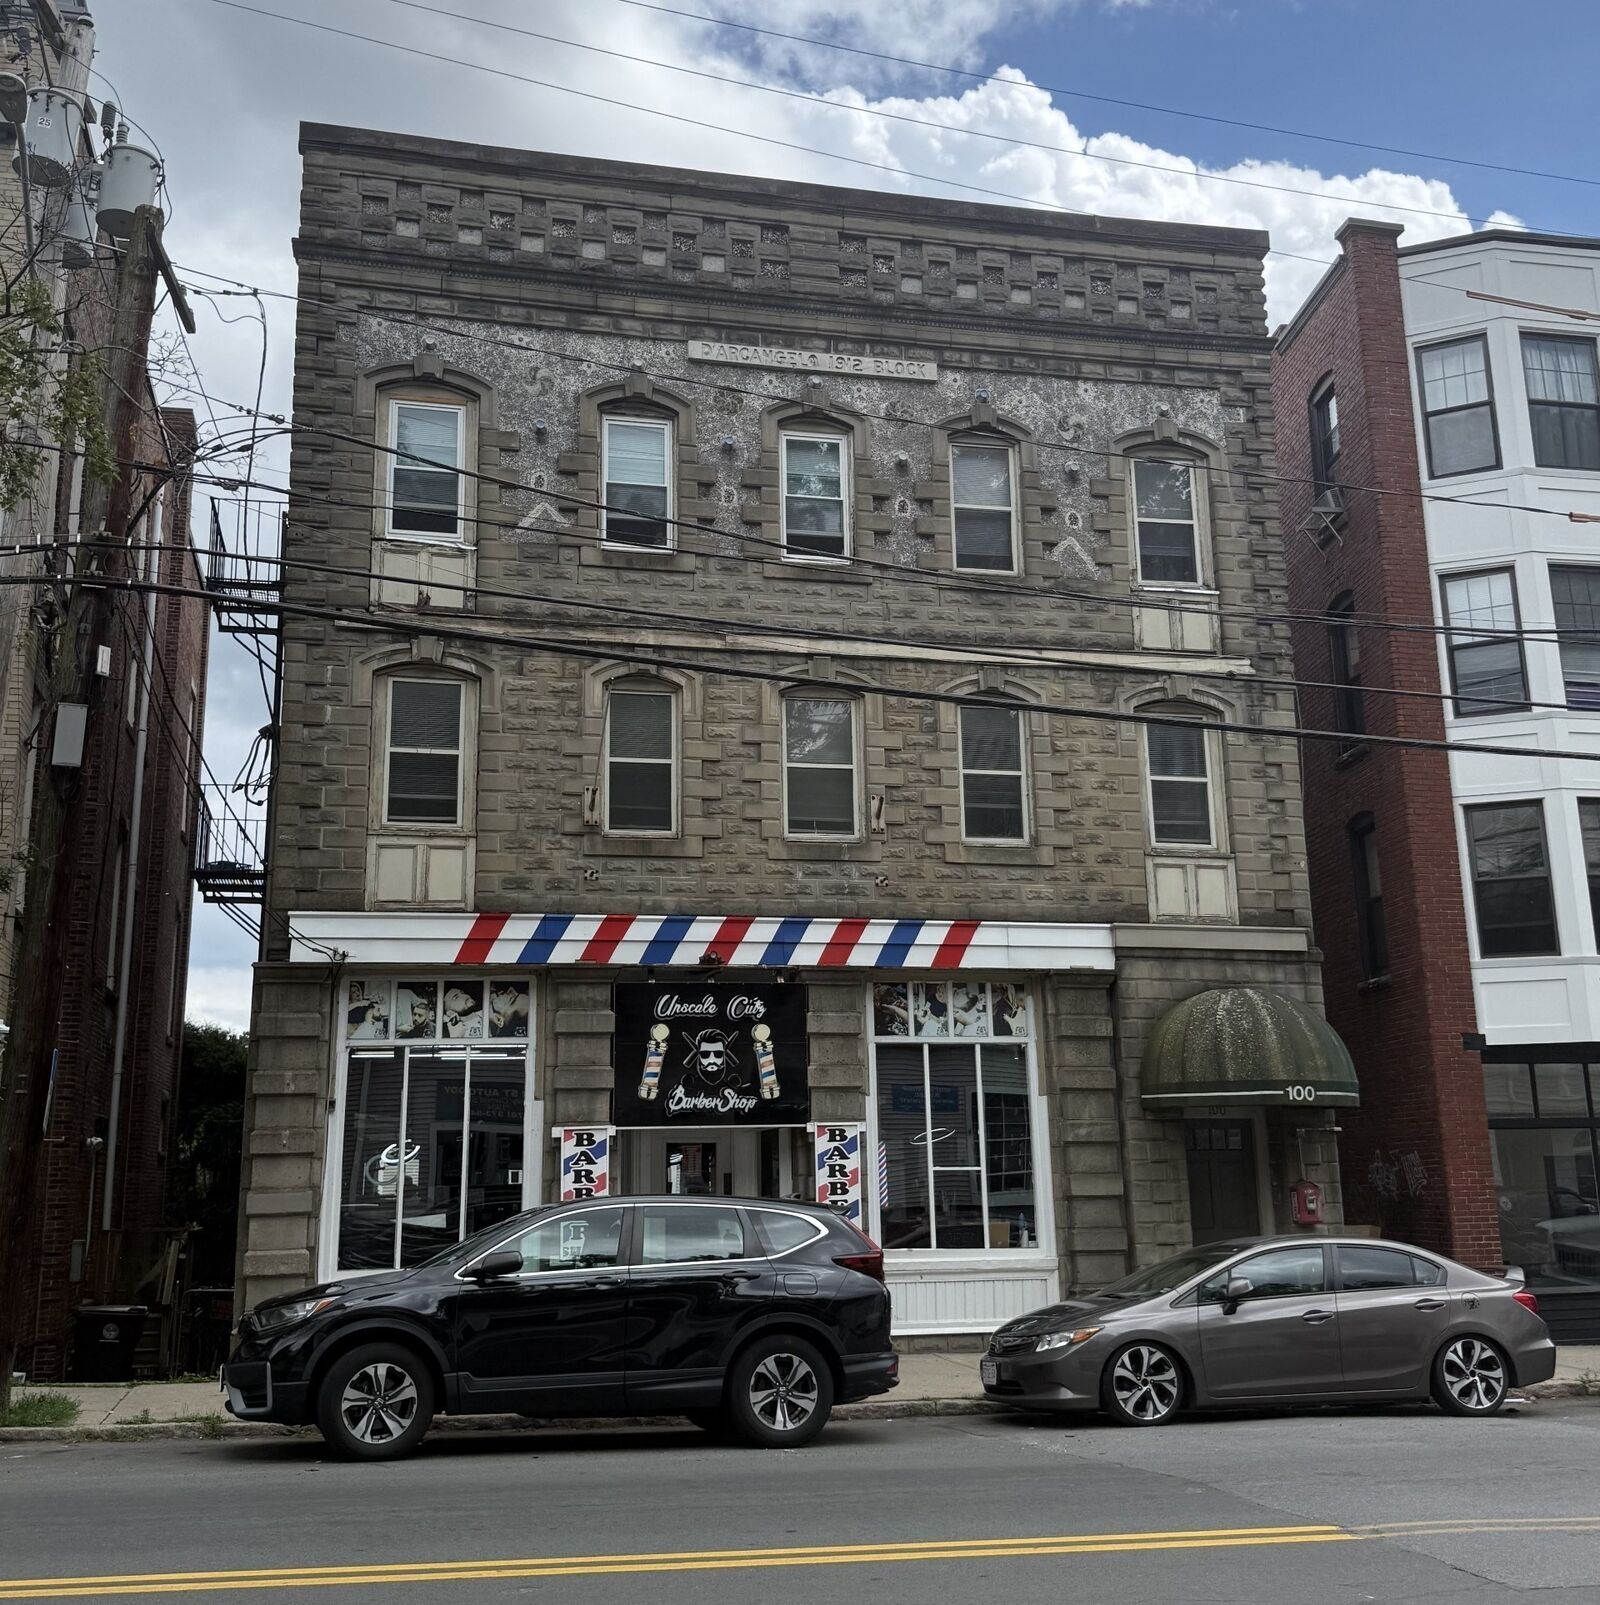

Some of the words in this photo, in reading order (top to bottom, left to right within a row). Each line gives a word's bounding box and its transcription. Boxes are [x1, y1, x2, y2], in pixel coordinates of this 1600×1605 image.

[38, 117, 51, 127] 25
[828, 355, 863, 371] 1912
[873, 360, 926, 378] BLOCK
[655, 994, 718, 1019] Upscale
[1285, 1085, 1315, 1101] 100
[571, 1131, 598, 1199] BARB
